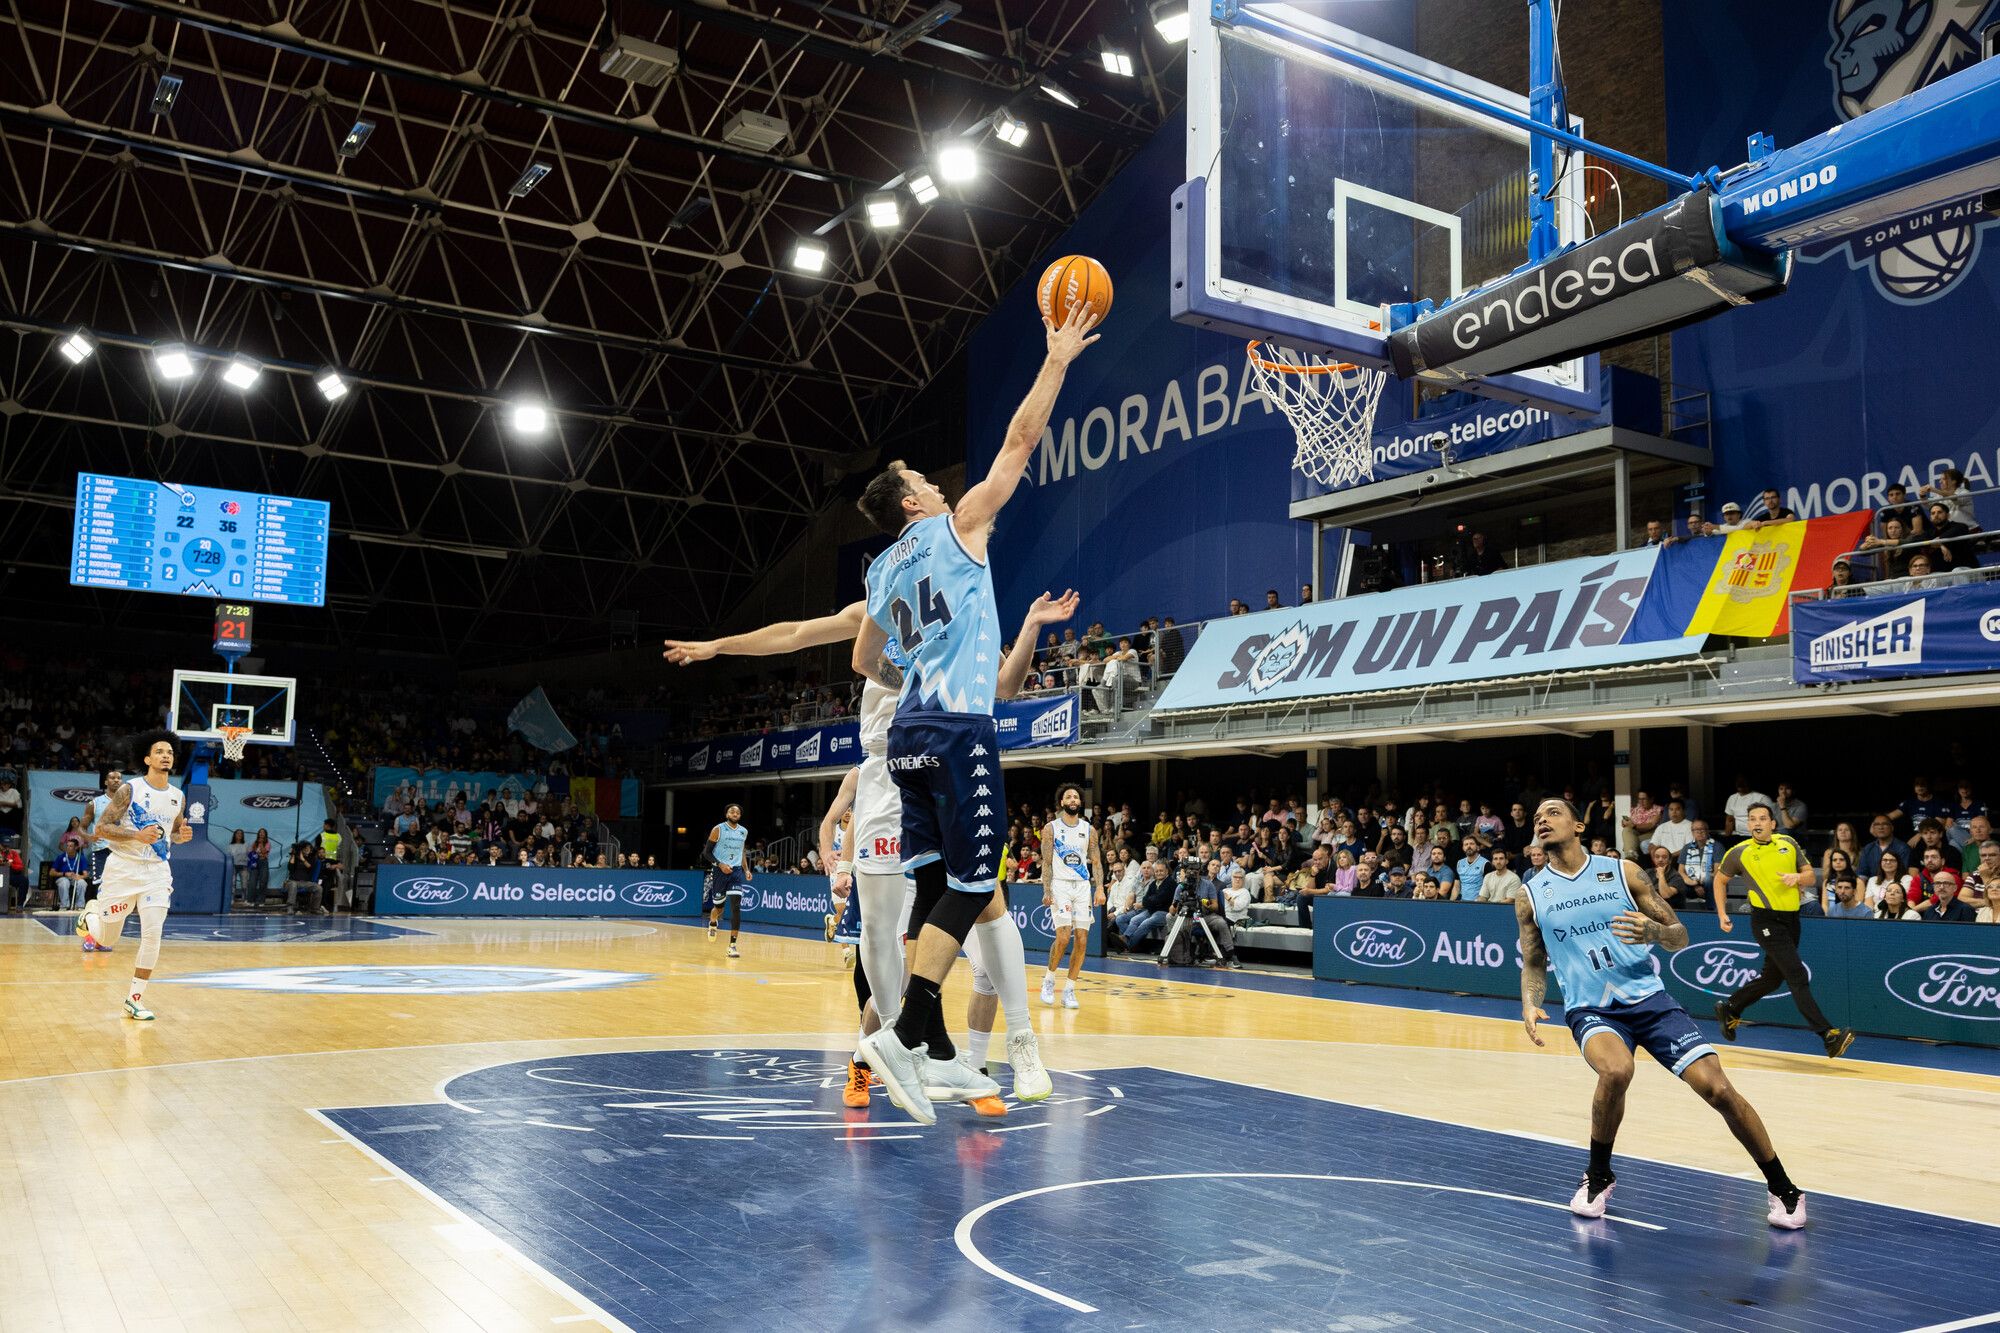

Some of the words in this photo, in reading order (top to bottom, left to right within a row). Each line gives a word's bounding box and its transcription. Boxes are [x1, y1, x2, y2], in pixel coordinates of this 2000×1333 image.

[1742, 165, 1838, 216] MONDO
[1864, 225, 1901, 247] SOM
[1909, 213, 1933, 230] UN
[1942, 200, 1983, 221] PAÍS
[1452, 237, 1660, 350] endesa
[1362, 432, 1437, 466] ndorr
[1787, 448, 2000, 519] MORABA
[177, 516, 194, 528] 22
[219, 520, 237, 533] 36
[193, 550, 221, 565] 7:28
[165, 567, 174, 579] 2
[232, 572, 241, 585] 0
[226, 605, 250, 616] 7:28
[890, 573, 955, 654] 24
[221, 620, 246, 639] 21
[1217, 620, 1359, 694] SM
[1353, 605, 1462, 675] UN
[1449, 560, 1649, 665] PAÍS
[1814, 615, 1913, 663] FINISHER
[1000, 717, 1018, 727] KERN
[1033, 709, 1068, 735] FINISHER
[252, 796, 289, 808] Ford
[407, 880, 454, 901] Ford
[473, 882, 524, 901] Auto
[530, 883, 616, 901] Selecció
[633, 884, 674, 903] Ford
[761, 890, 783, 909] Auto
[785, 893, 828, 913] Selecció
[1555, 891, 1619, 912] MORABANC
[1569, 919, 1623, 938] Andor
[1350, 926, 1408, 961] Ford
[1432, 931, 1504, 967] Auto
[1587, 945, 1615, 971] 11
[1695, 947, 1762, 988] For
[1918, 961, 2000, 1007] For
